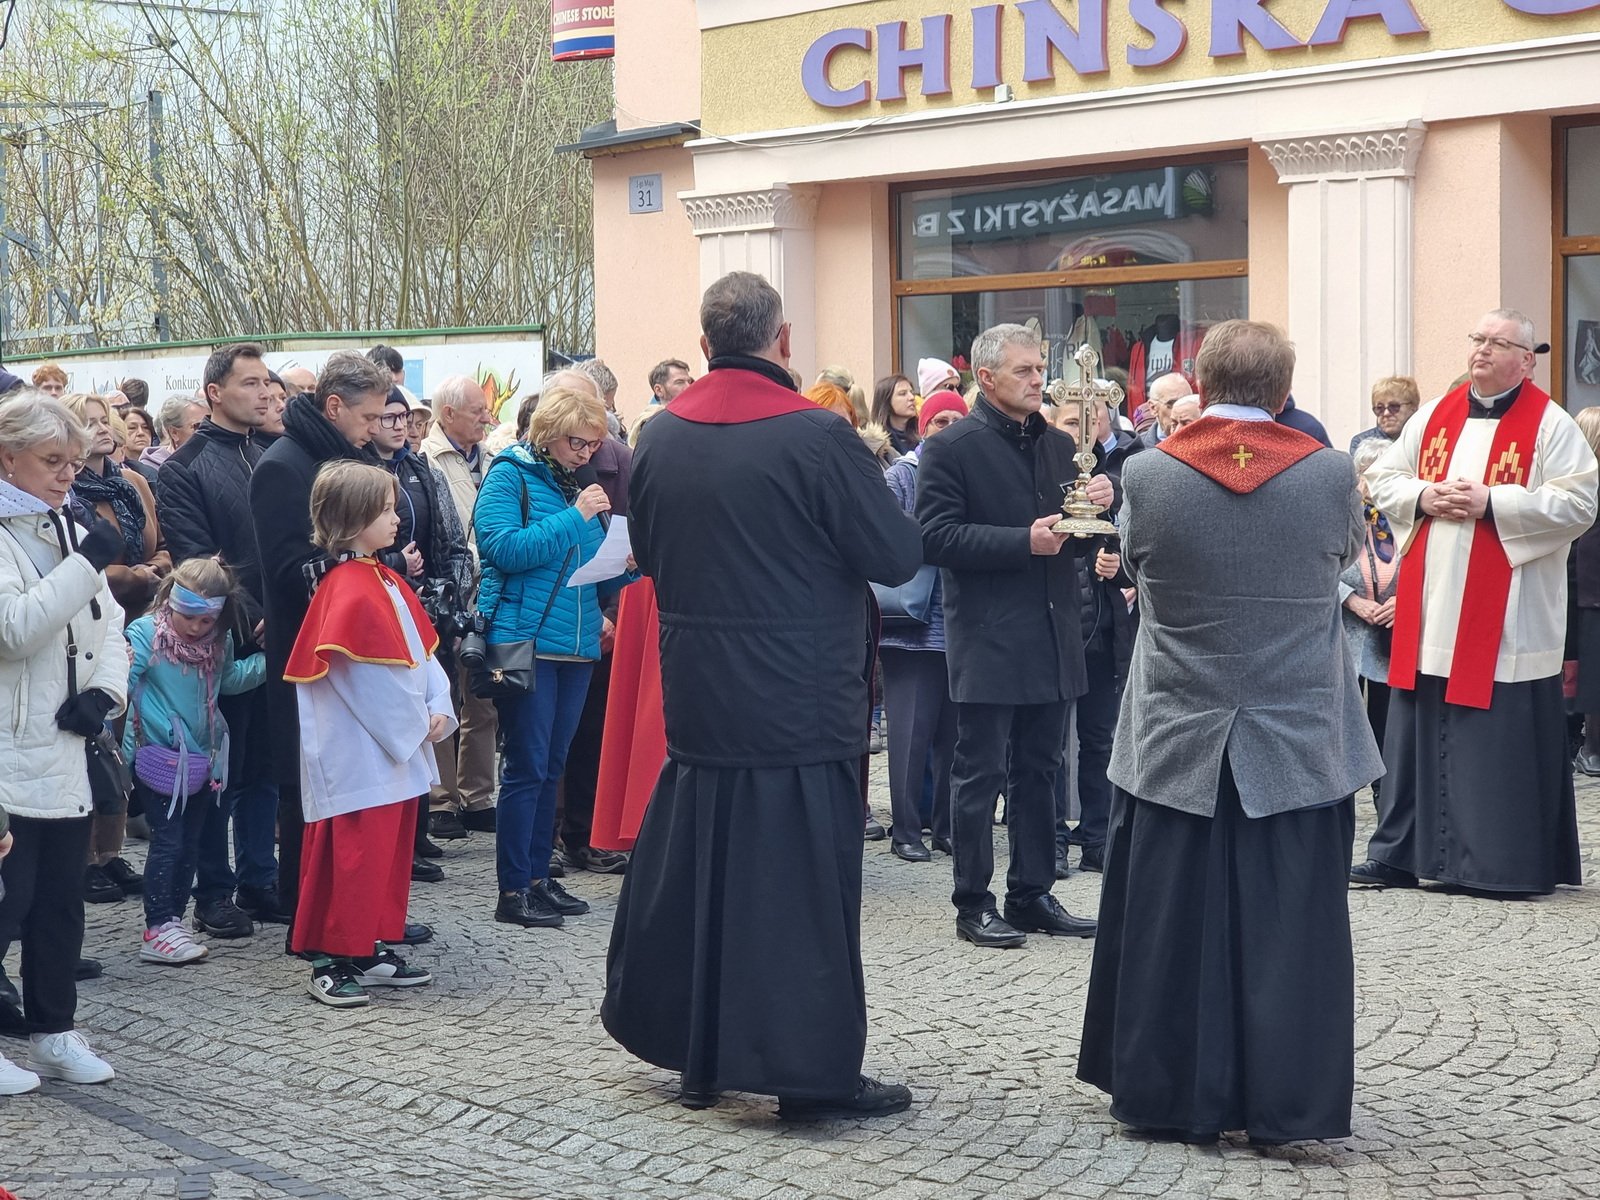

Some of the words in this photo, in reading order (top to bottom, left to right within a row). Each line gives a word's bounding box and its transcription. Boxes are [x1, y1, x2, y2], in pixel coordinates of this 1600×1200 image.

[582, 6, 614, 20] STORE
[638, 190, 653, 207] 31
[165, 375, 201, 391] Konkurs
